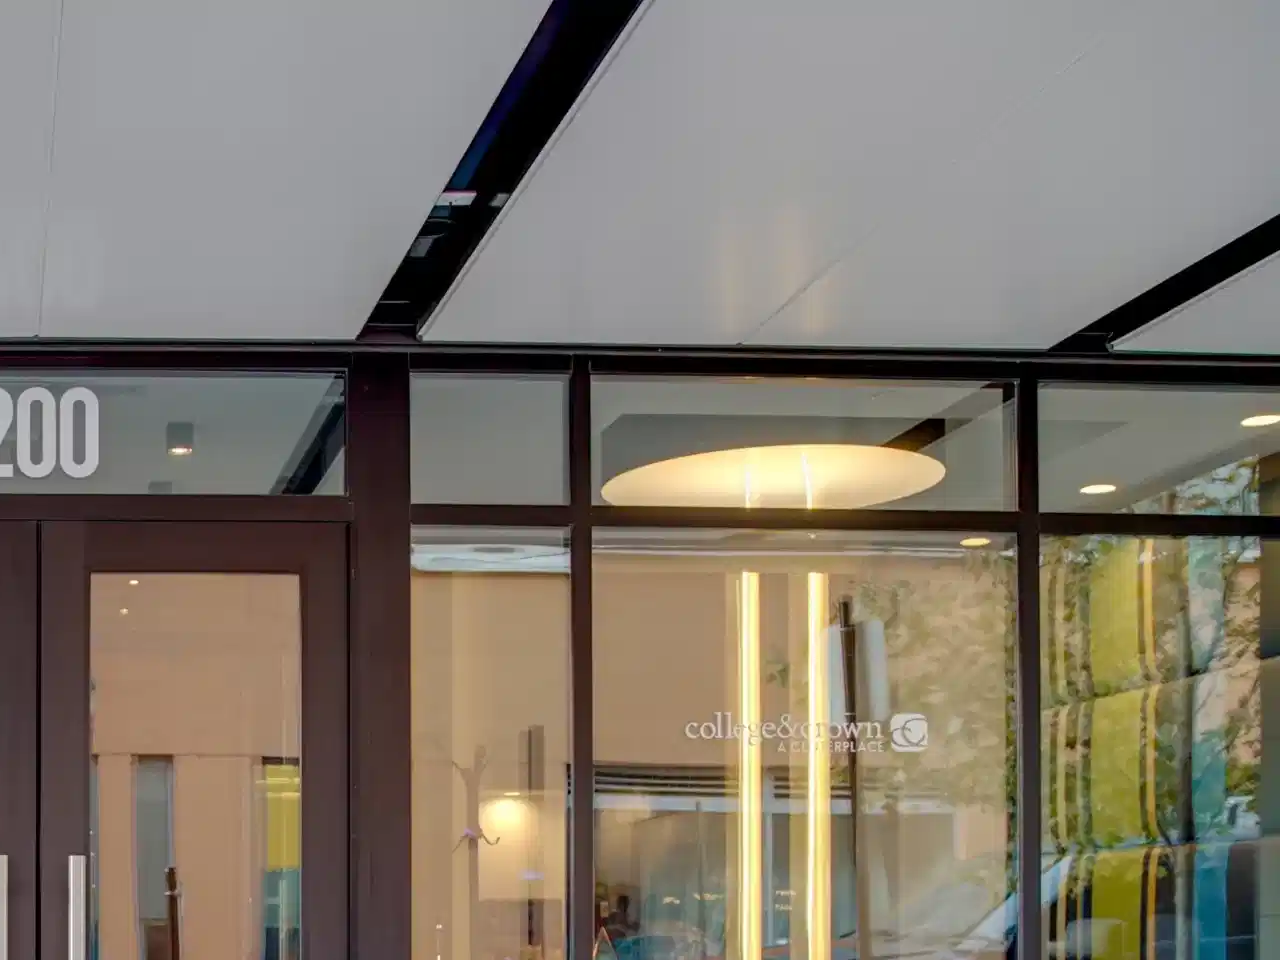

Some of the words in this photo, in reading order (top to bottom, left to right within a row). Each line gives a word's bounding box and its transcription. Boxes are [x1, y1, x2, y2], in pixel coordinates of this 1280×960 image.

[685, 711, 884, 746] college&crown
[777, 740, 787, 753] A
[789, 740, 885, 753] CEERPLACE
